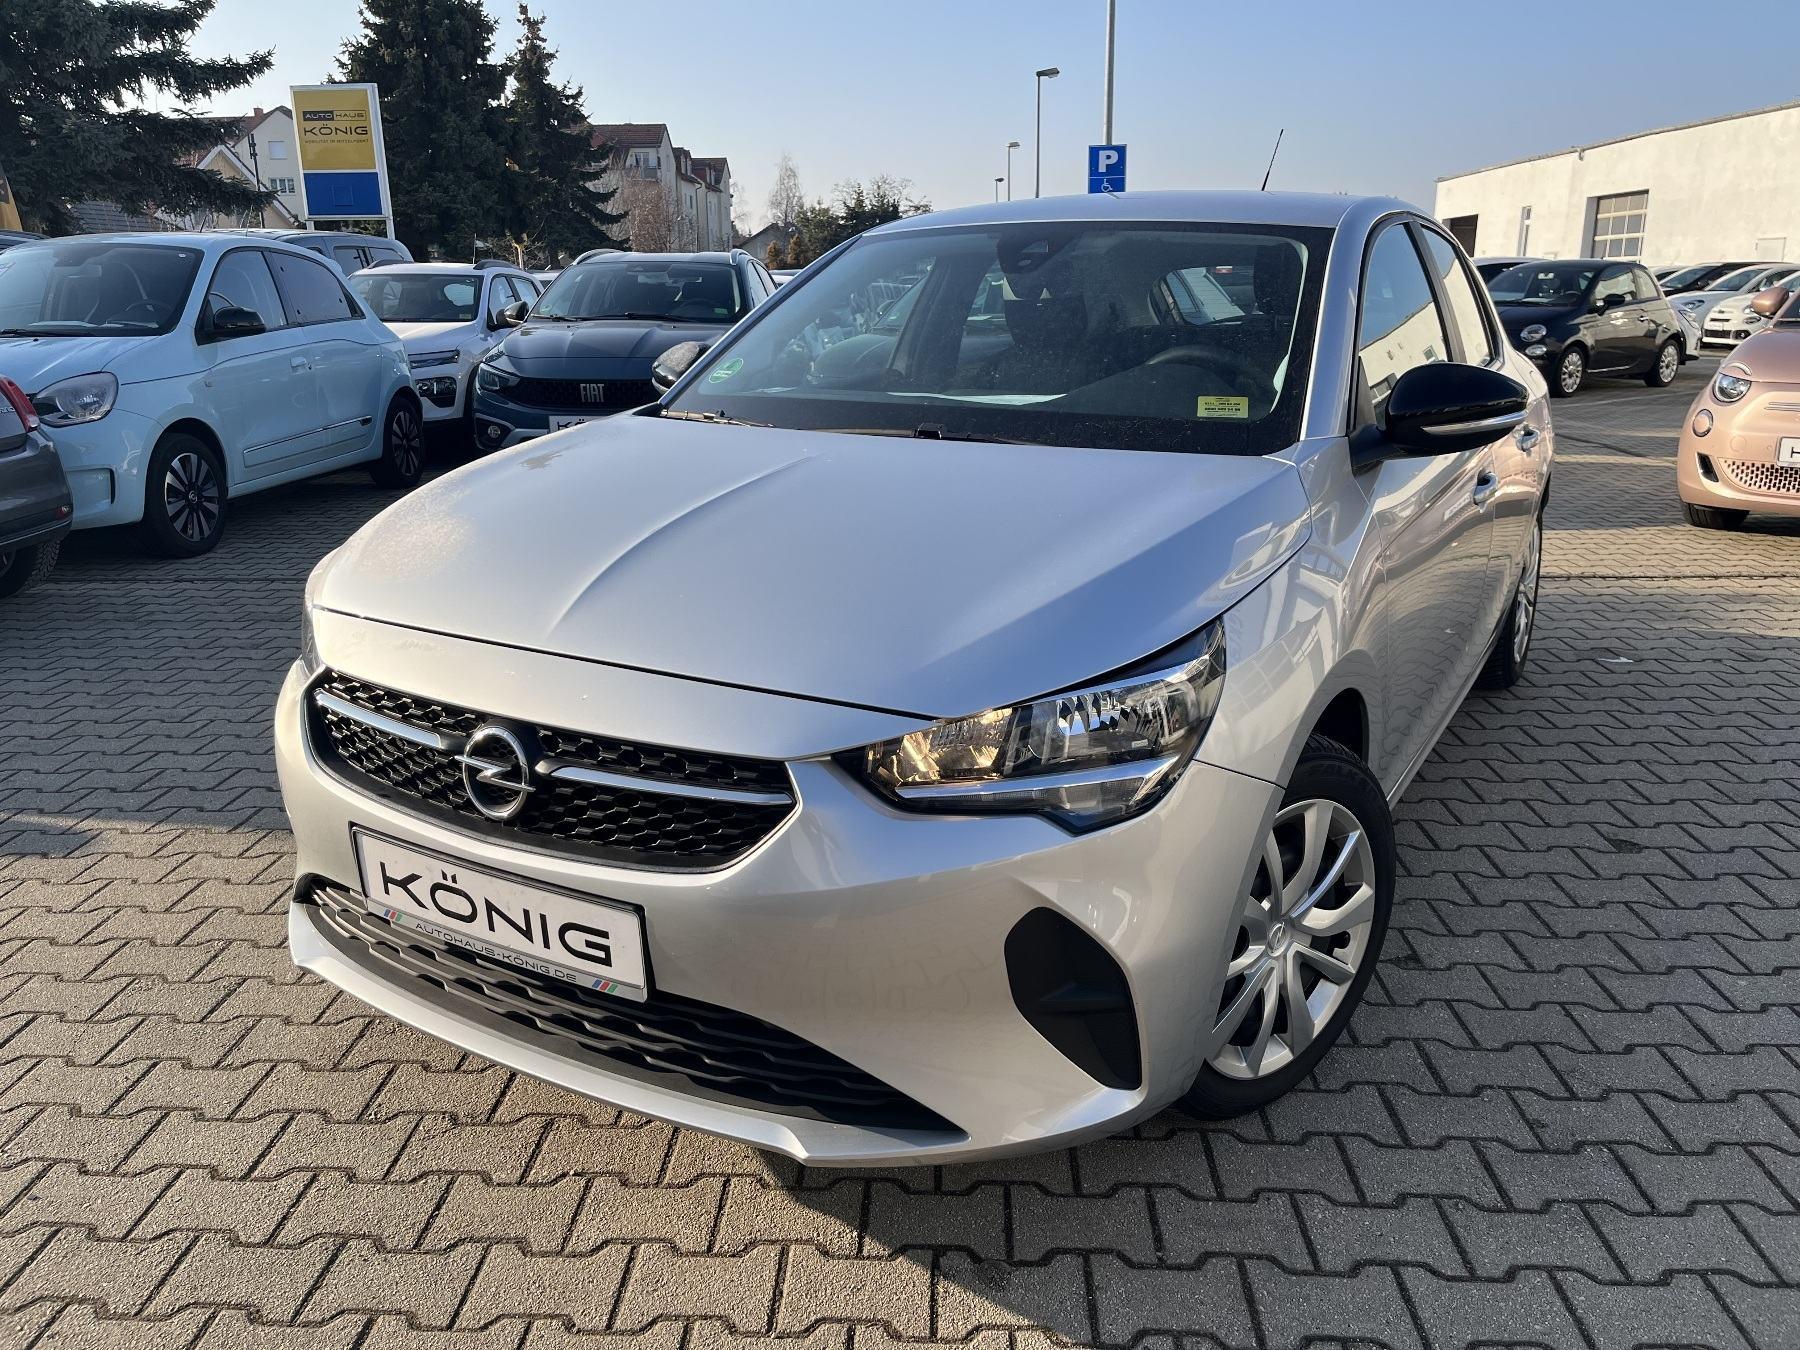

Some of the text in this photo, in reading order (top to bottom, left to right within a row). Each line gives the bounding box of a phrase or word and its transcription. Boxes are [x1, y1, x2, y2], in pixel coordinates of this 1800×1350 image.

[303, 123, 369, 136] KÖNIG
[1098, 150, 1119, 173] P
[580, 383, 605, 402] FIAT
[379, 861, 613, 968] KÖNIG
[415, 922, 578, 983] AUTOHAUS-KÖNIG.DE
